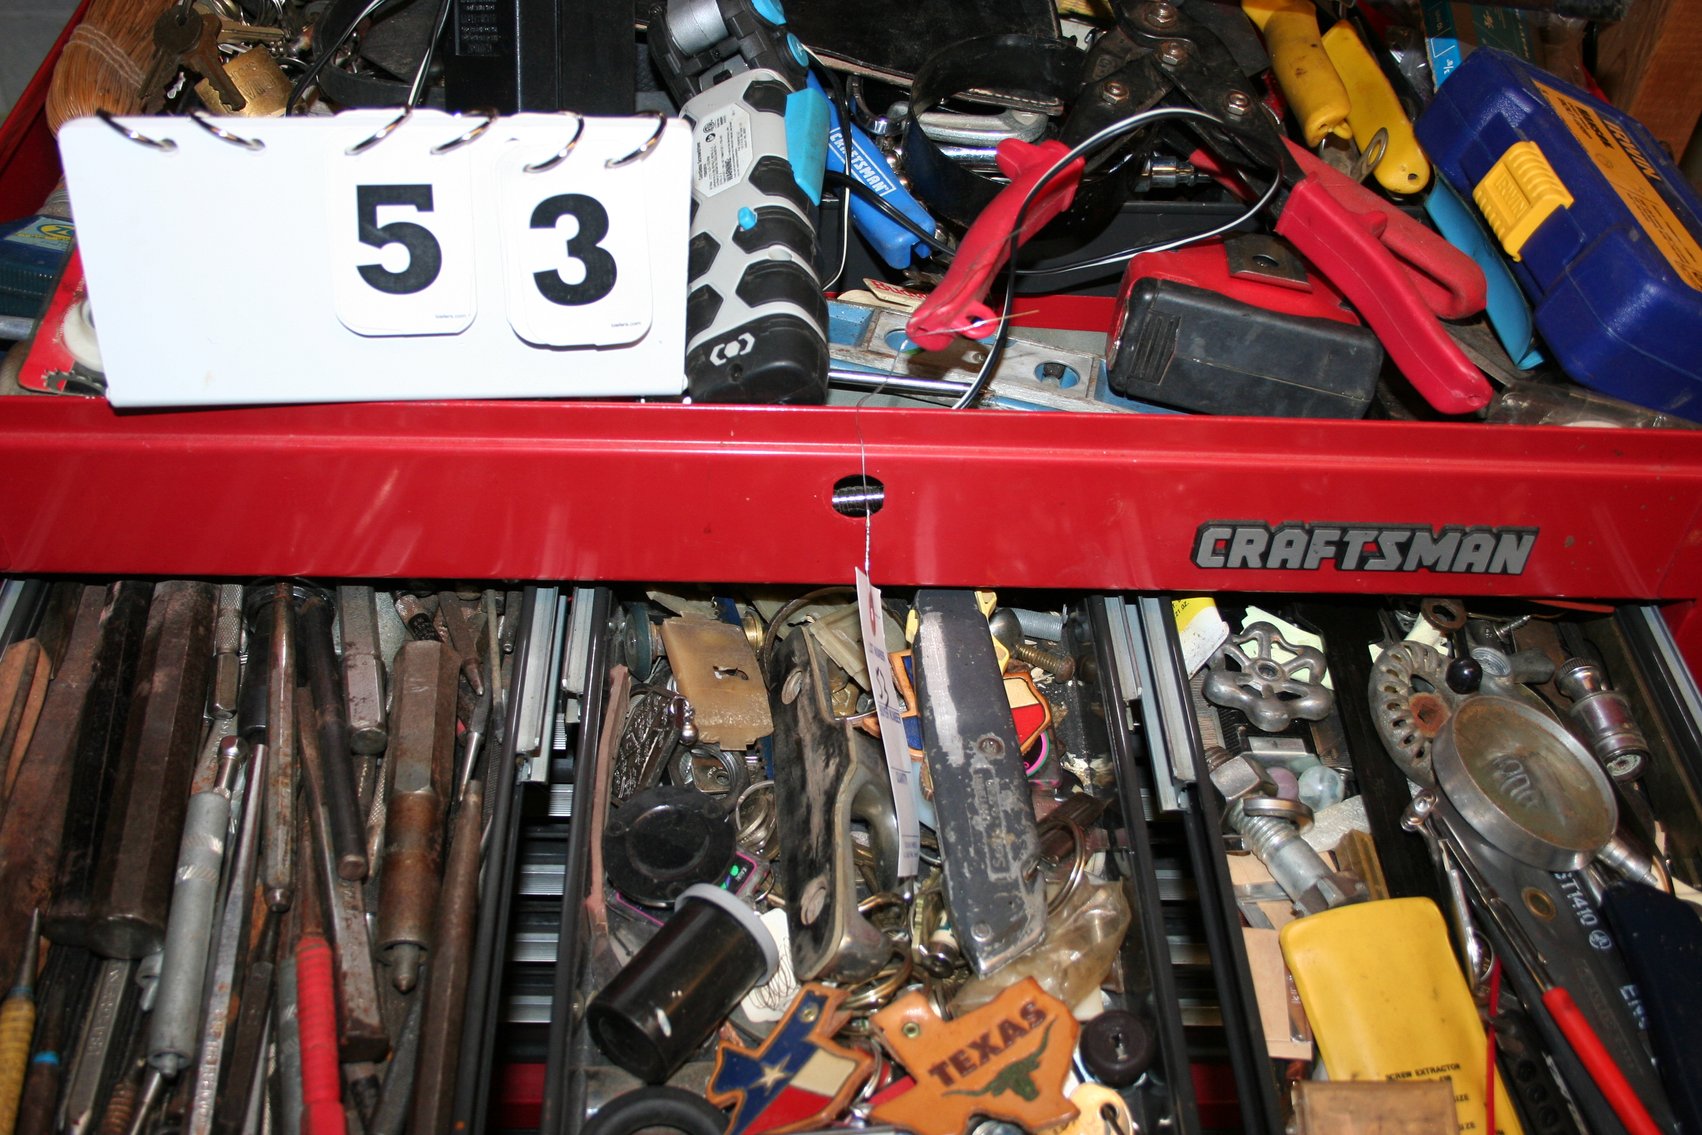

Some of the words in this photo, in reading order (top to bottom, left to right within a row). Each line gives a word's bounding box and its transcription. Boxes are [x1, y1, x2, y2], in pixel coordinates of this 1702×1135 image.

[1604, 119, 1662, 182] IRWIN
[1495, 175, 1529, 219] IRWIN
[356, 184, 443, 294] 5
[530, 193, 617, 306] 3
[1194, 525, 1538, 574] CRAFTSMAN
[928, 1000, 1049, 1087] TEXAS
[1414, 1063, 1461, 1077] EXTRACTOR
